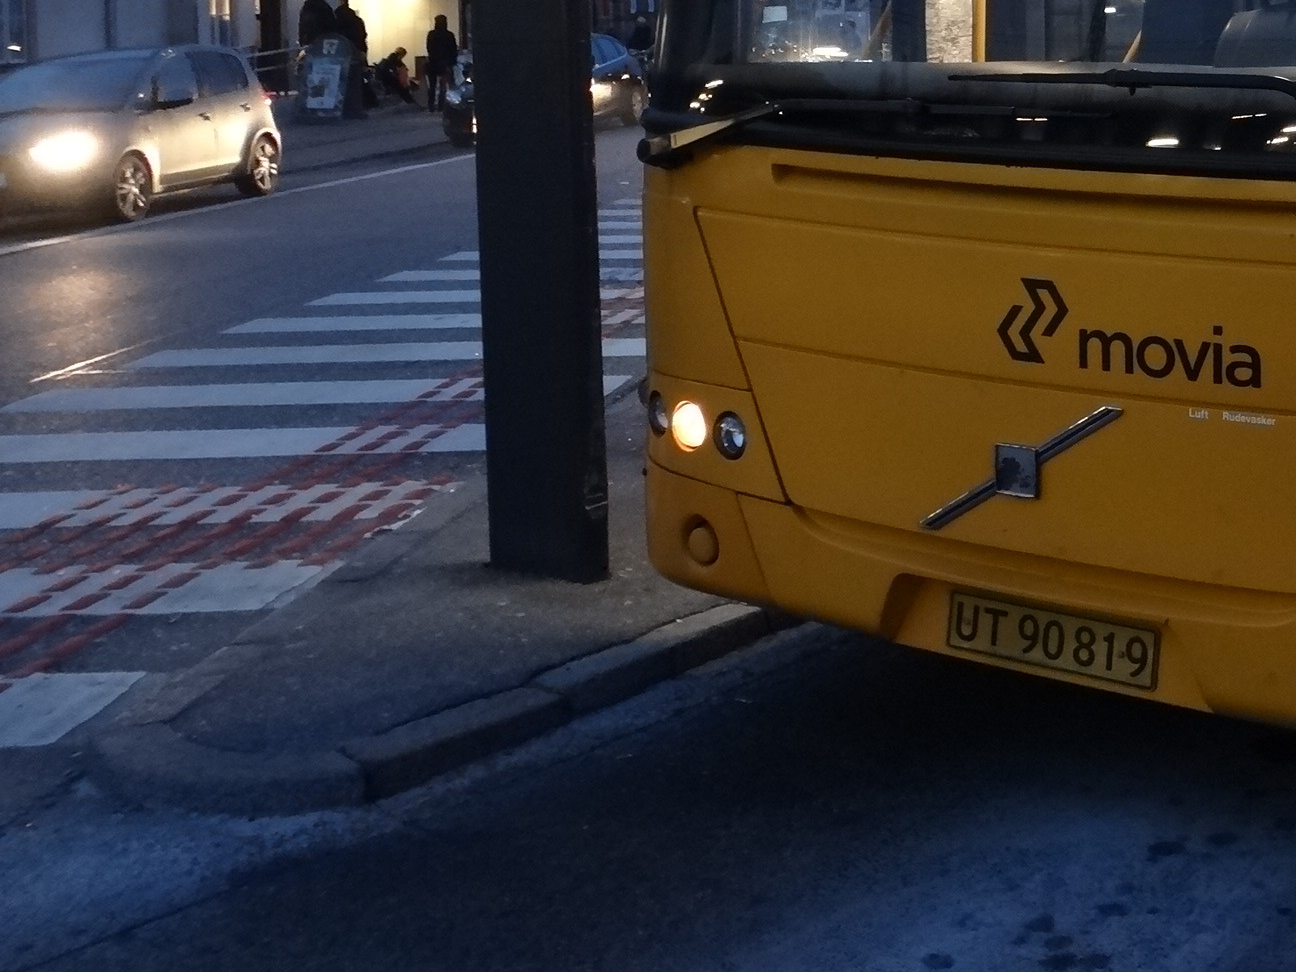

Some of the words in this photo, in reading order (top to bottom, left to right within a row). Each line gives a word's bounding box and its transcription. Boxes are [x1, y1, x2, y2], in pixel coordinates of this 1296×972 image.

[1078, 325, 1262, 389] movia
[1188, 407, 1210, 420] Luft
[1222, 411, 1277, 426] Rudevasker
[955, 601, 1009, 647] UT
[1018, 614, 1066, 661] 90
